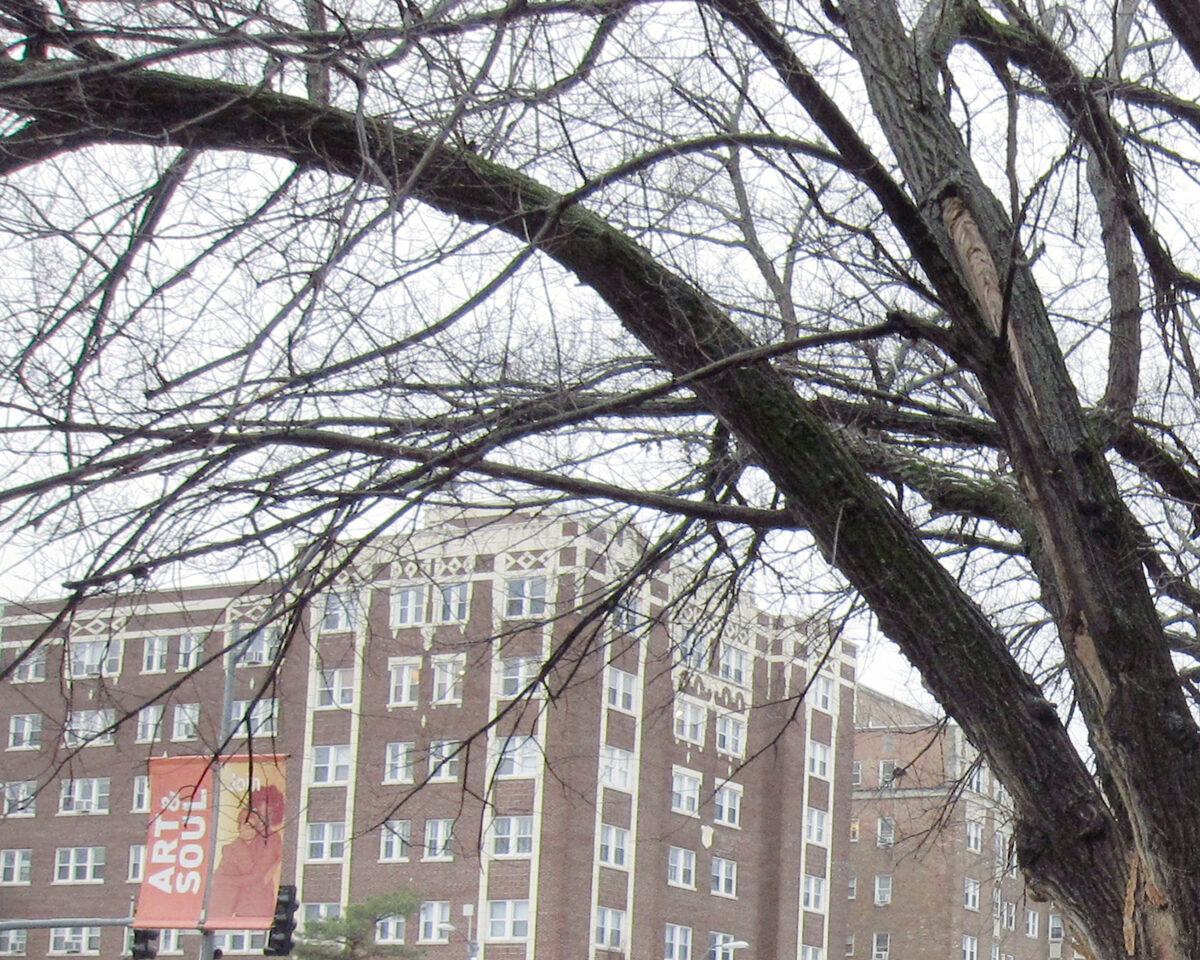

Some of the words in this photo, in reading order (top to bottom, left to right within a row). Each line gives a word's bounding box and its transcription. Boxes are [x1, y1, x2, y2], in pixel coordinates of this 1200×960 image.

[161, 792, 181, 812] &
[176, 789, 208, 895] SOUL
[148, 813, 180, 894] ART
